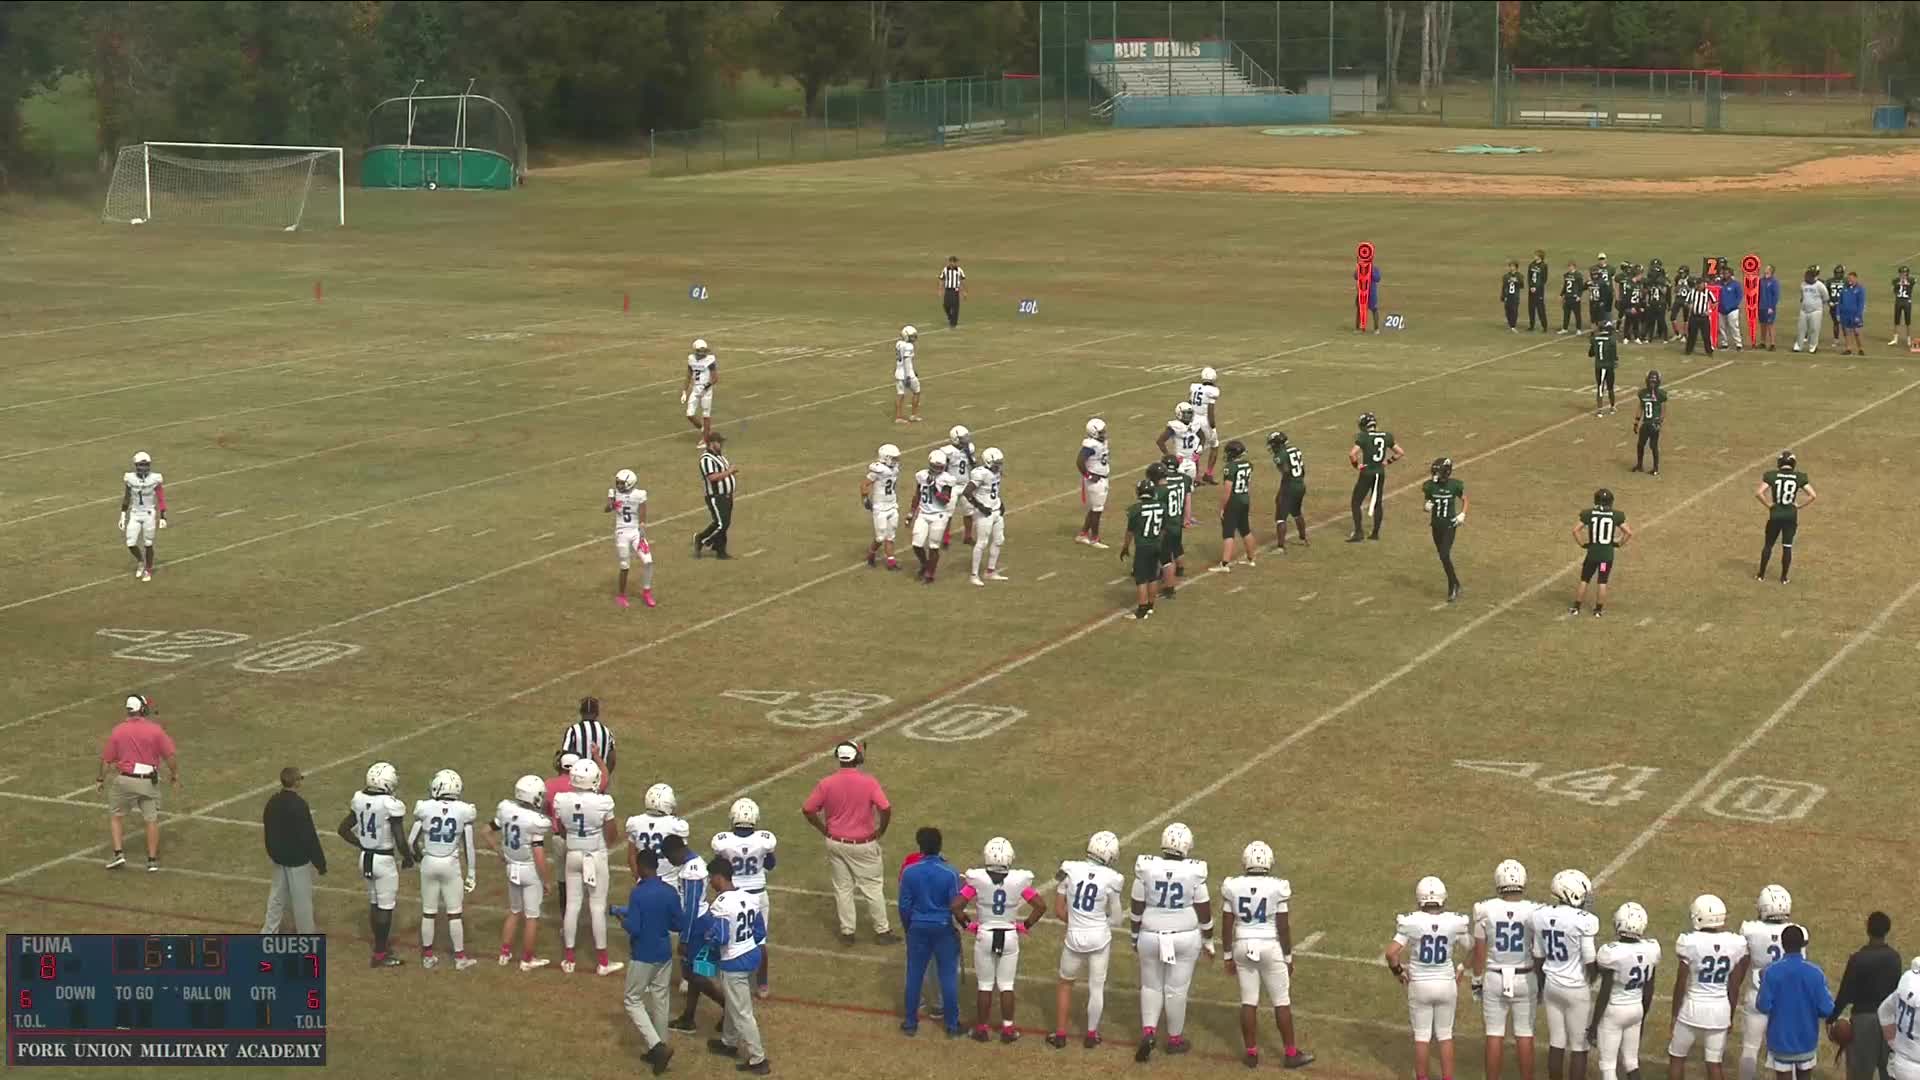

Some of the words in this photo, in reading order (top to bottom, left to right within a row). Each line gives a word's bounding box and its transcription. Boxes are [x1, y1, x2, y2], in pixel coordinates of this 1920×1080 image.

[1114, 42, 1147, 57] BLUE
[1153, 42, 1201, 57] DEVILS
[1707, 258, 1717, 275] 2
[1508, 281, 1516, 295] 8
[1597, 341, 1604, 360] 1
[1192, 391, 1203, 406] 15
[1644, 401, 1653, 419] 0
[1182, 435, 1194, 449] 12
[1372, 437, 1385, 462] 3
[959, 460, 966, 475] 9
[138, 490, 144, 506] 1
[1775, 479, 1797, 505] 18
[622, 506, 632, 524] 5
[1435, 498, 1449, 518] 11
[1141, 509, 1164, 537] 75
[1591, 517, 1613, 544] 10
[359, 811, 377, 840] 14
[428, 816, 458, 844] 23
[503, 823, 521, 850] 13
[572, 813, 586, 838] 7
[731, 855, 759, 876] 26
[992, 889, 1007, 916] 8
[1071, 880, 1098, 913] 18
[1155, 881, 1184, 909] 72
[1238, 896, 1267, 924] 54
[735, 908, 756, 943] 29
[1495, 921, 1525, 953] 52
[1419, 934, 1449, 965] 66
[1542, 929, 1569, 962] 75
[1624, 964, 1650, 991] 21
[1698, 955, 1731, 984] 22
[1897, 997, 1916, 1041] 77
